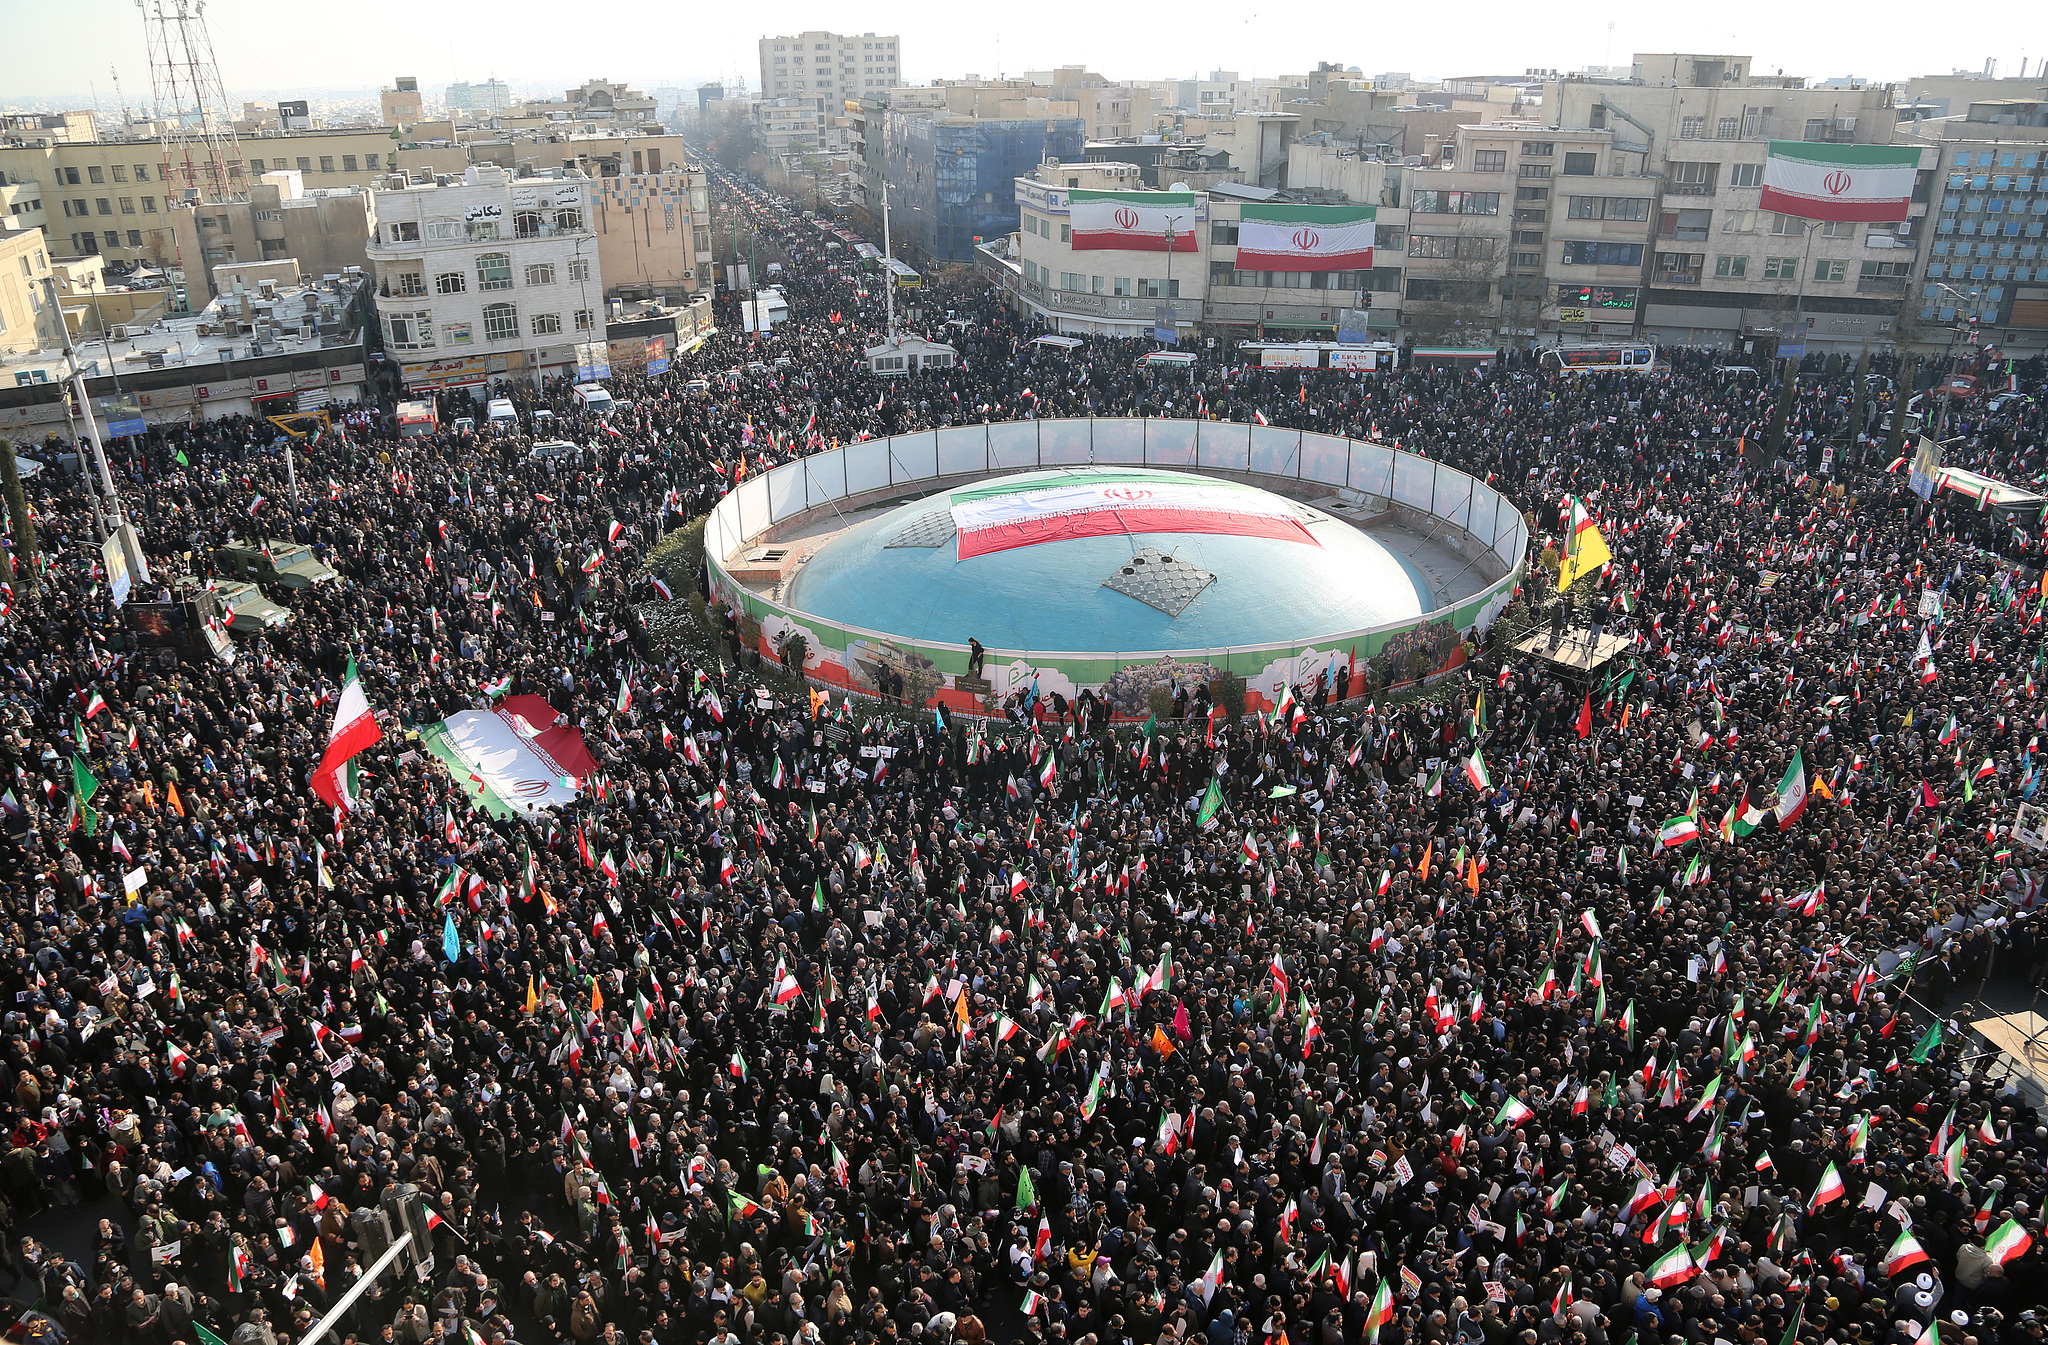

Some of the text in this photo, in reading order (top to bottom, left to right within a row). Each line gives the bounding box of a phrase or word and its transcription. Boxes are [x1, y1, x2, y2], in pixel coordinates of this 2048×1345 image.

[1560, 309, 1585, 321] عکاسی
[1262, 354, 1304, 362] AMBULANCE
[426, 364, 443, 373] کتاب
[310, 572, 333, 584] NOPO
[265, 612, 287, 627] NOPO
